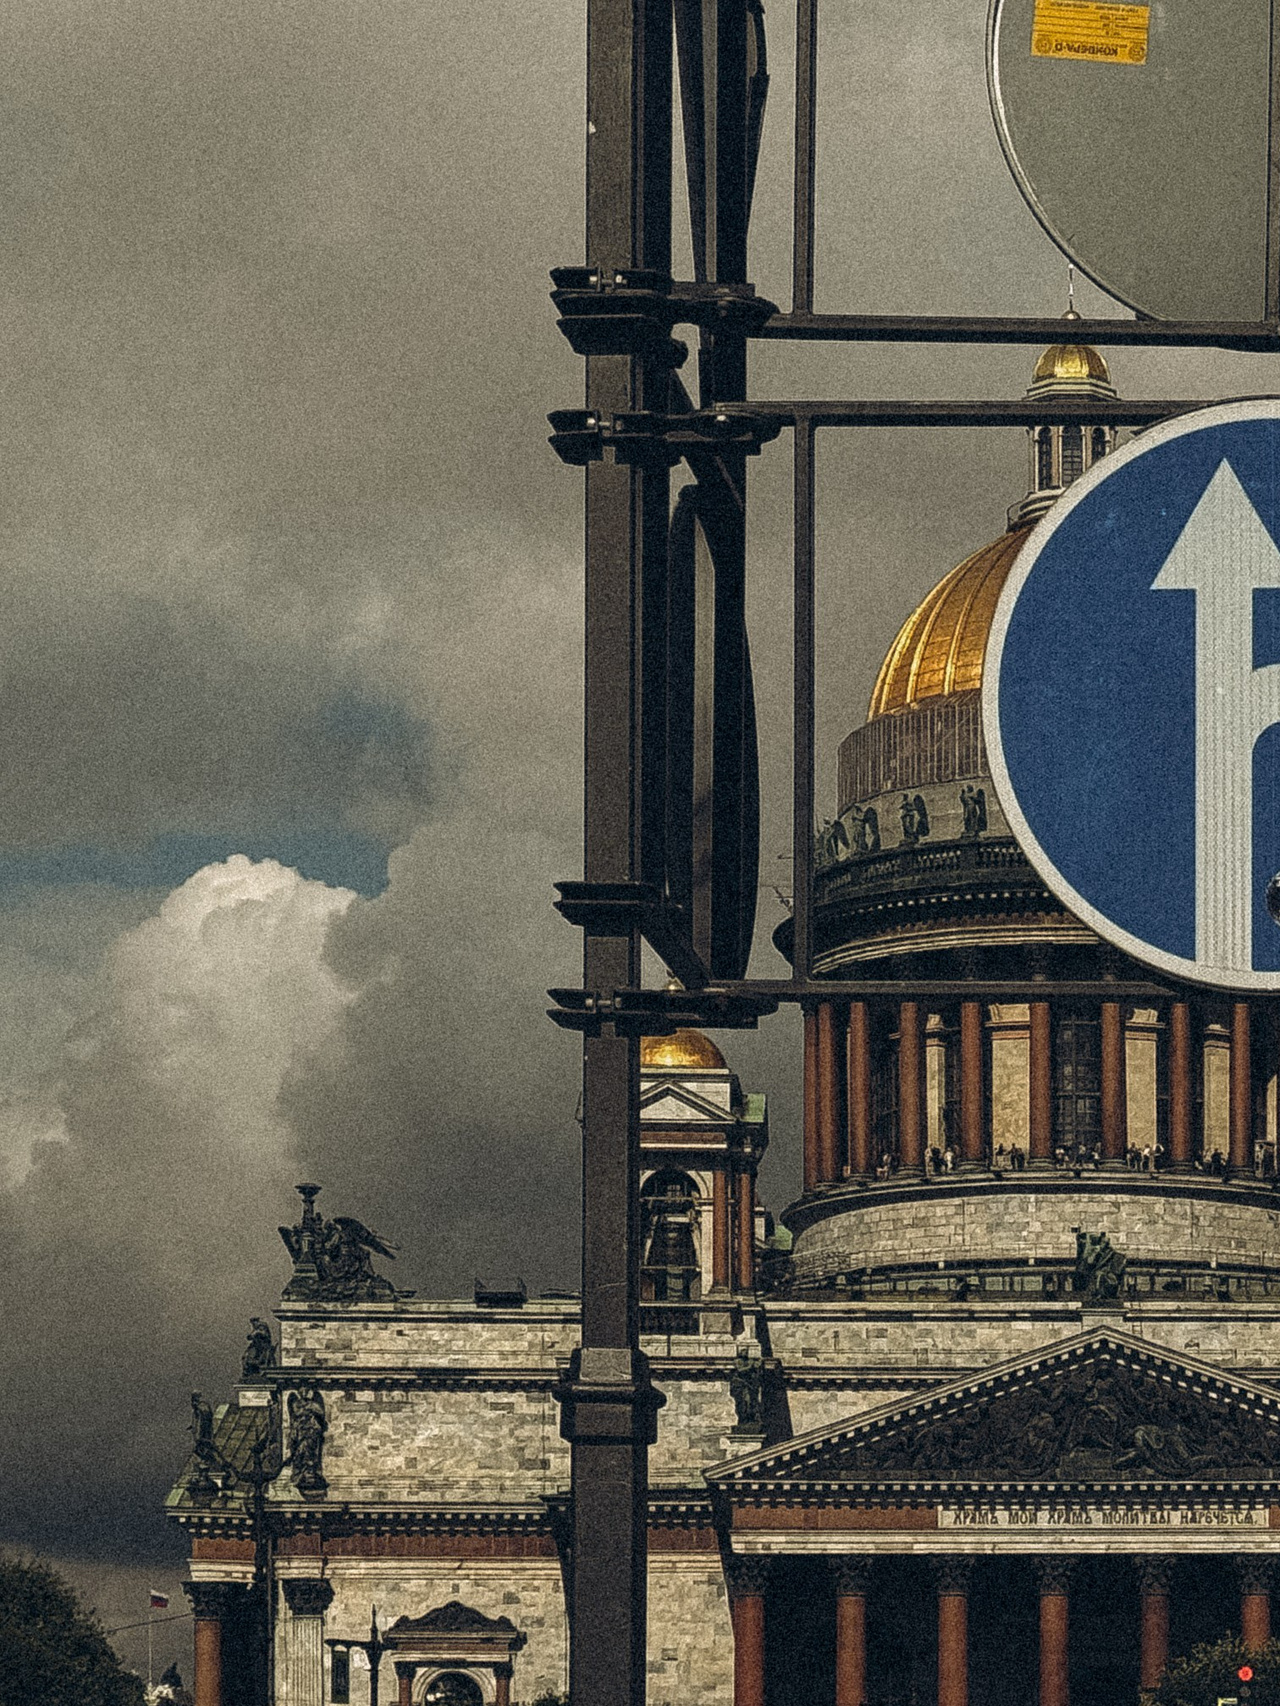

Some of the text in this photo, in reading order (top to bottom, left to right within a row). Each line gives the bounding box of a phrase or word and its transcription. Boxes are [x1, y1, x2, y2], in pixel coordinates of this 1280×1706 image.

[953, 1509, 999, 1525] ХРАМЪ
[1048, 1509, 1093, 1525] ХРАМЪ
[1102, 1509, 1171, 1525] МОЛИТВЫ
